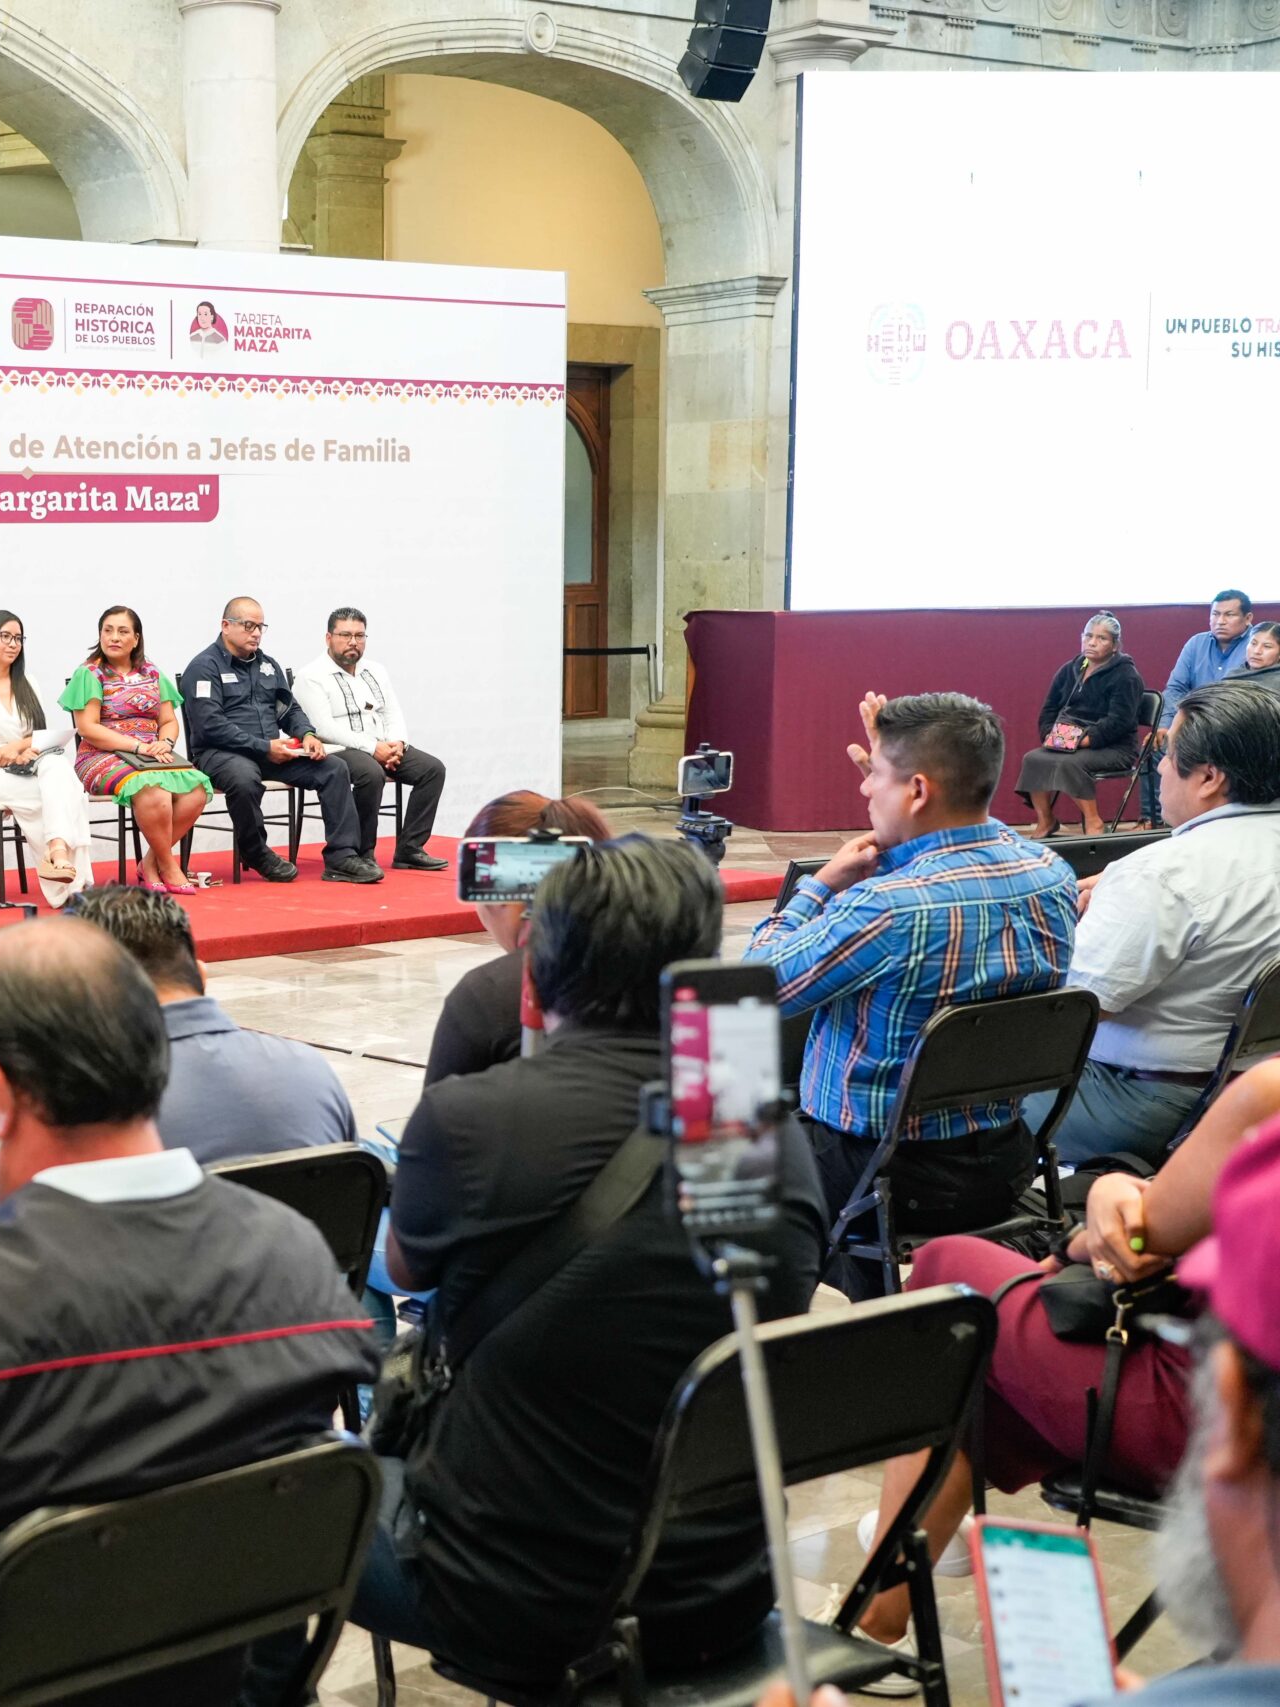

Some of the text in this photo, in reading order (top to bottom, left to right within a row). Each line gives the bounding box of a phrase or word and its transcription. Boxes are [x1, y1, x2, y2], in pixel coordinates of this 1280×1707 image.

[74, 302, 154, 317] REPARACIÓN
[75, 316, 155, 334] HISTÓRICA
[234, 312, 283, 326] TARJETA
[1166, 318, 1187, 334] UN
[1191, 317, 1252, 334] PUEBLO
[75, 334, 156, 346] DE LOS PUEBLOS
[234, 325, 312, 340] MARGARITA
[945, 319, 1132, 360] OAXACA
[234, 338, 279, 353] MAZA
[1231, 342, 1252, 358] SU
[8, 433, 45, 459] de
[53, 433, 179, 461] Atención
[186, 441, 201, 461] a
[209, 436, 277, 462] Jefas
[284, 438, 316, 462] de
[323, 437, 411, 463] Familia
[124, 483, 210, 512] Maza"
